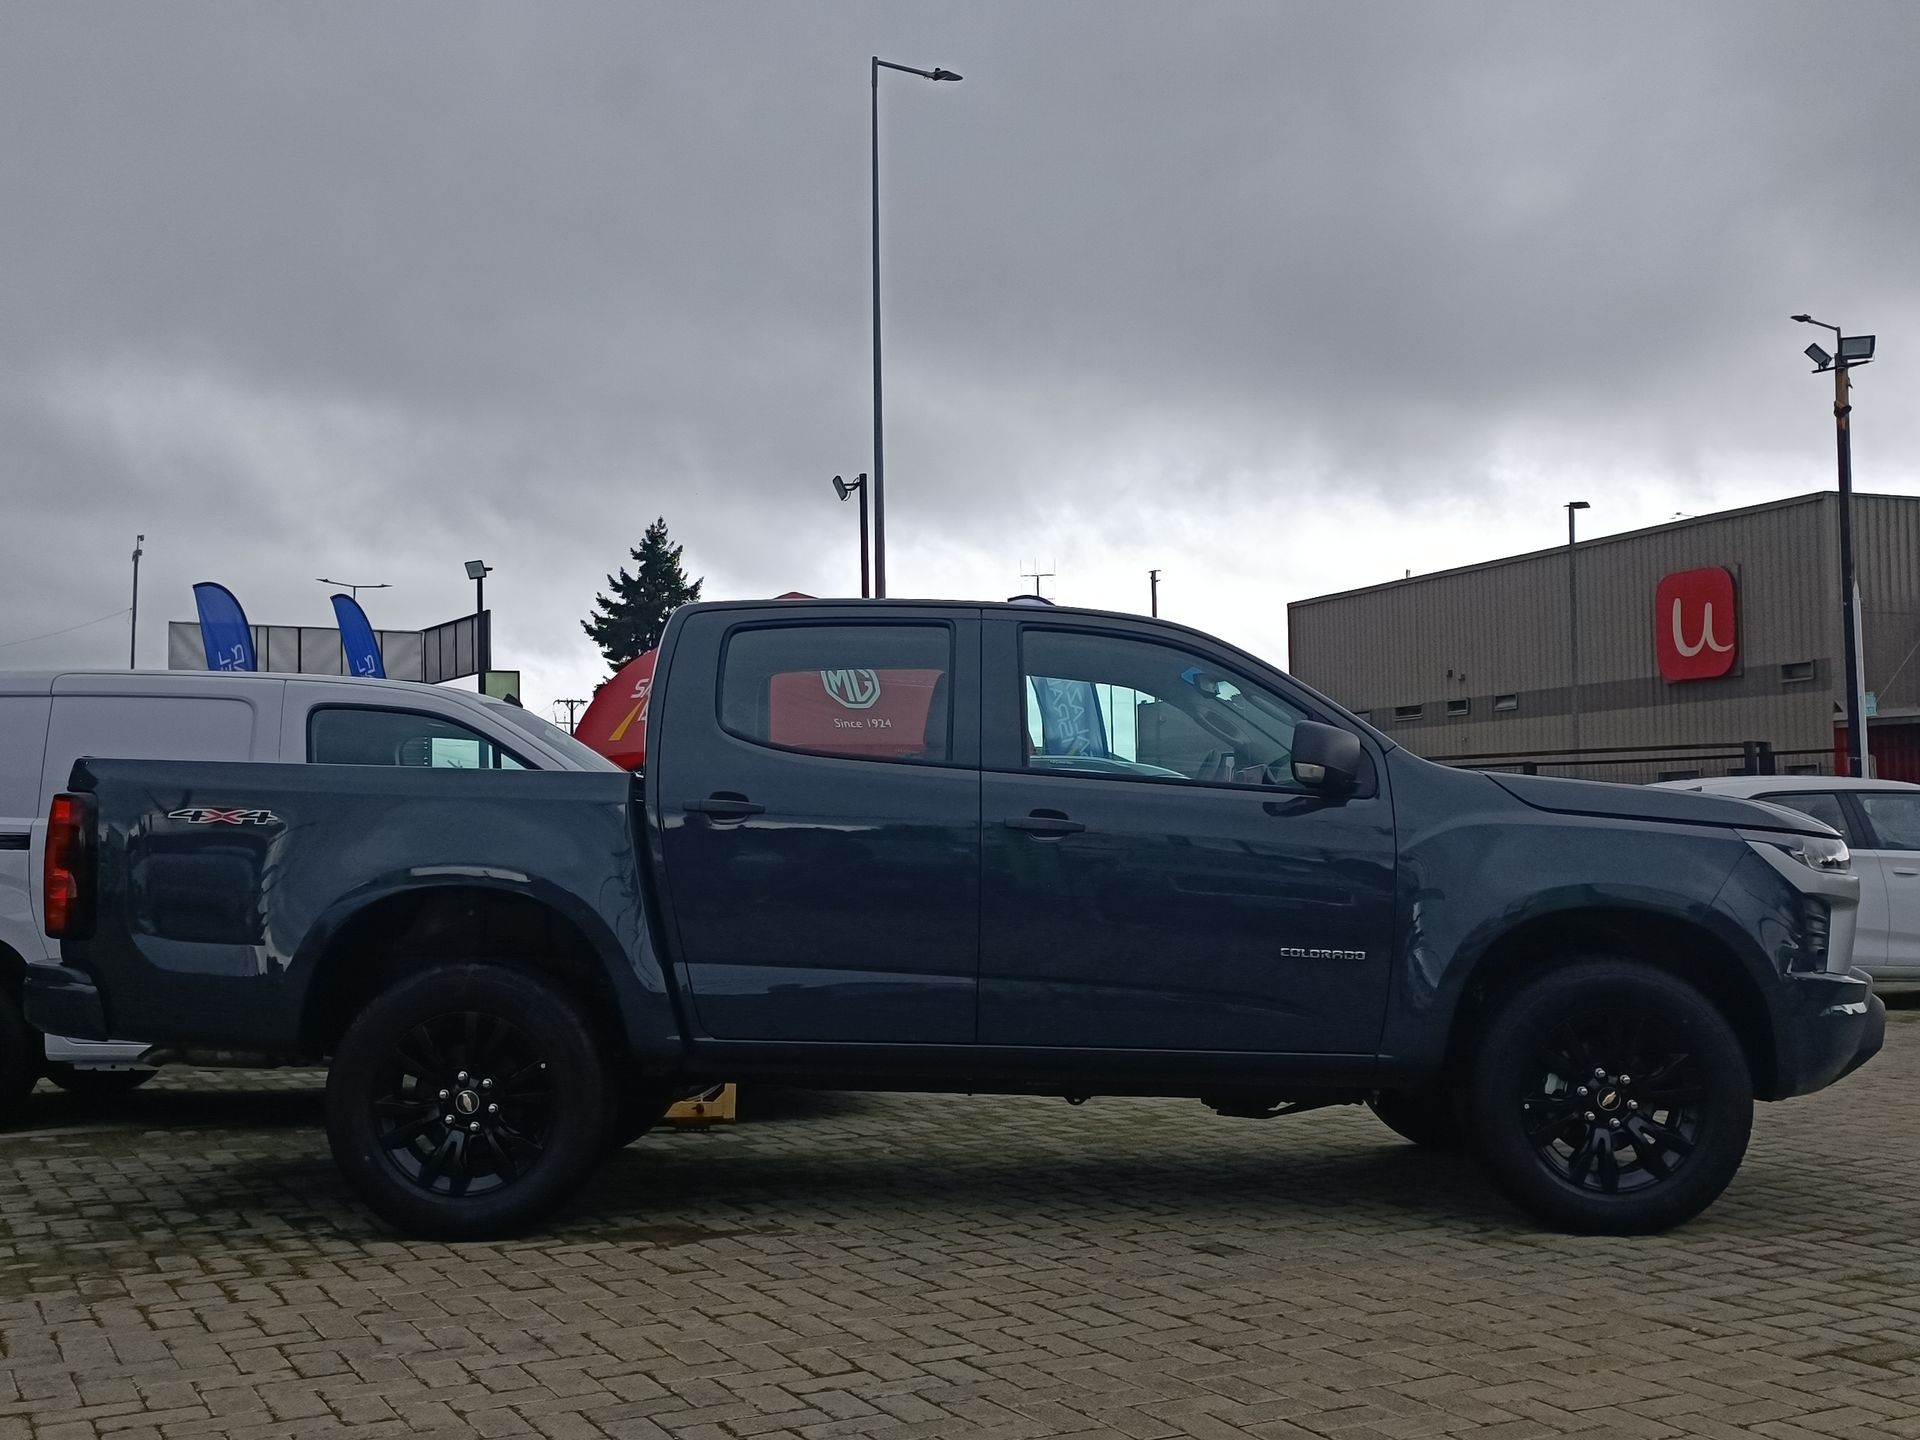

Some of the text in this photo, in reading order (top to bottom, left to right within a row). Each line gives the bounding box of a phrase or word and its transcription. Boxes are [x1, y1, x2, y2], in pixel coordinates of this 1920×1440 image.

[826, 669, 873, 702] MG
[832, 717, 892, 729] Since 1924
[1280, 947, 1366, 960] COLORADO
